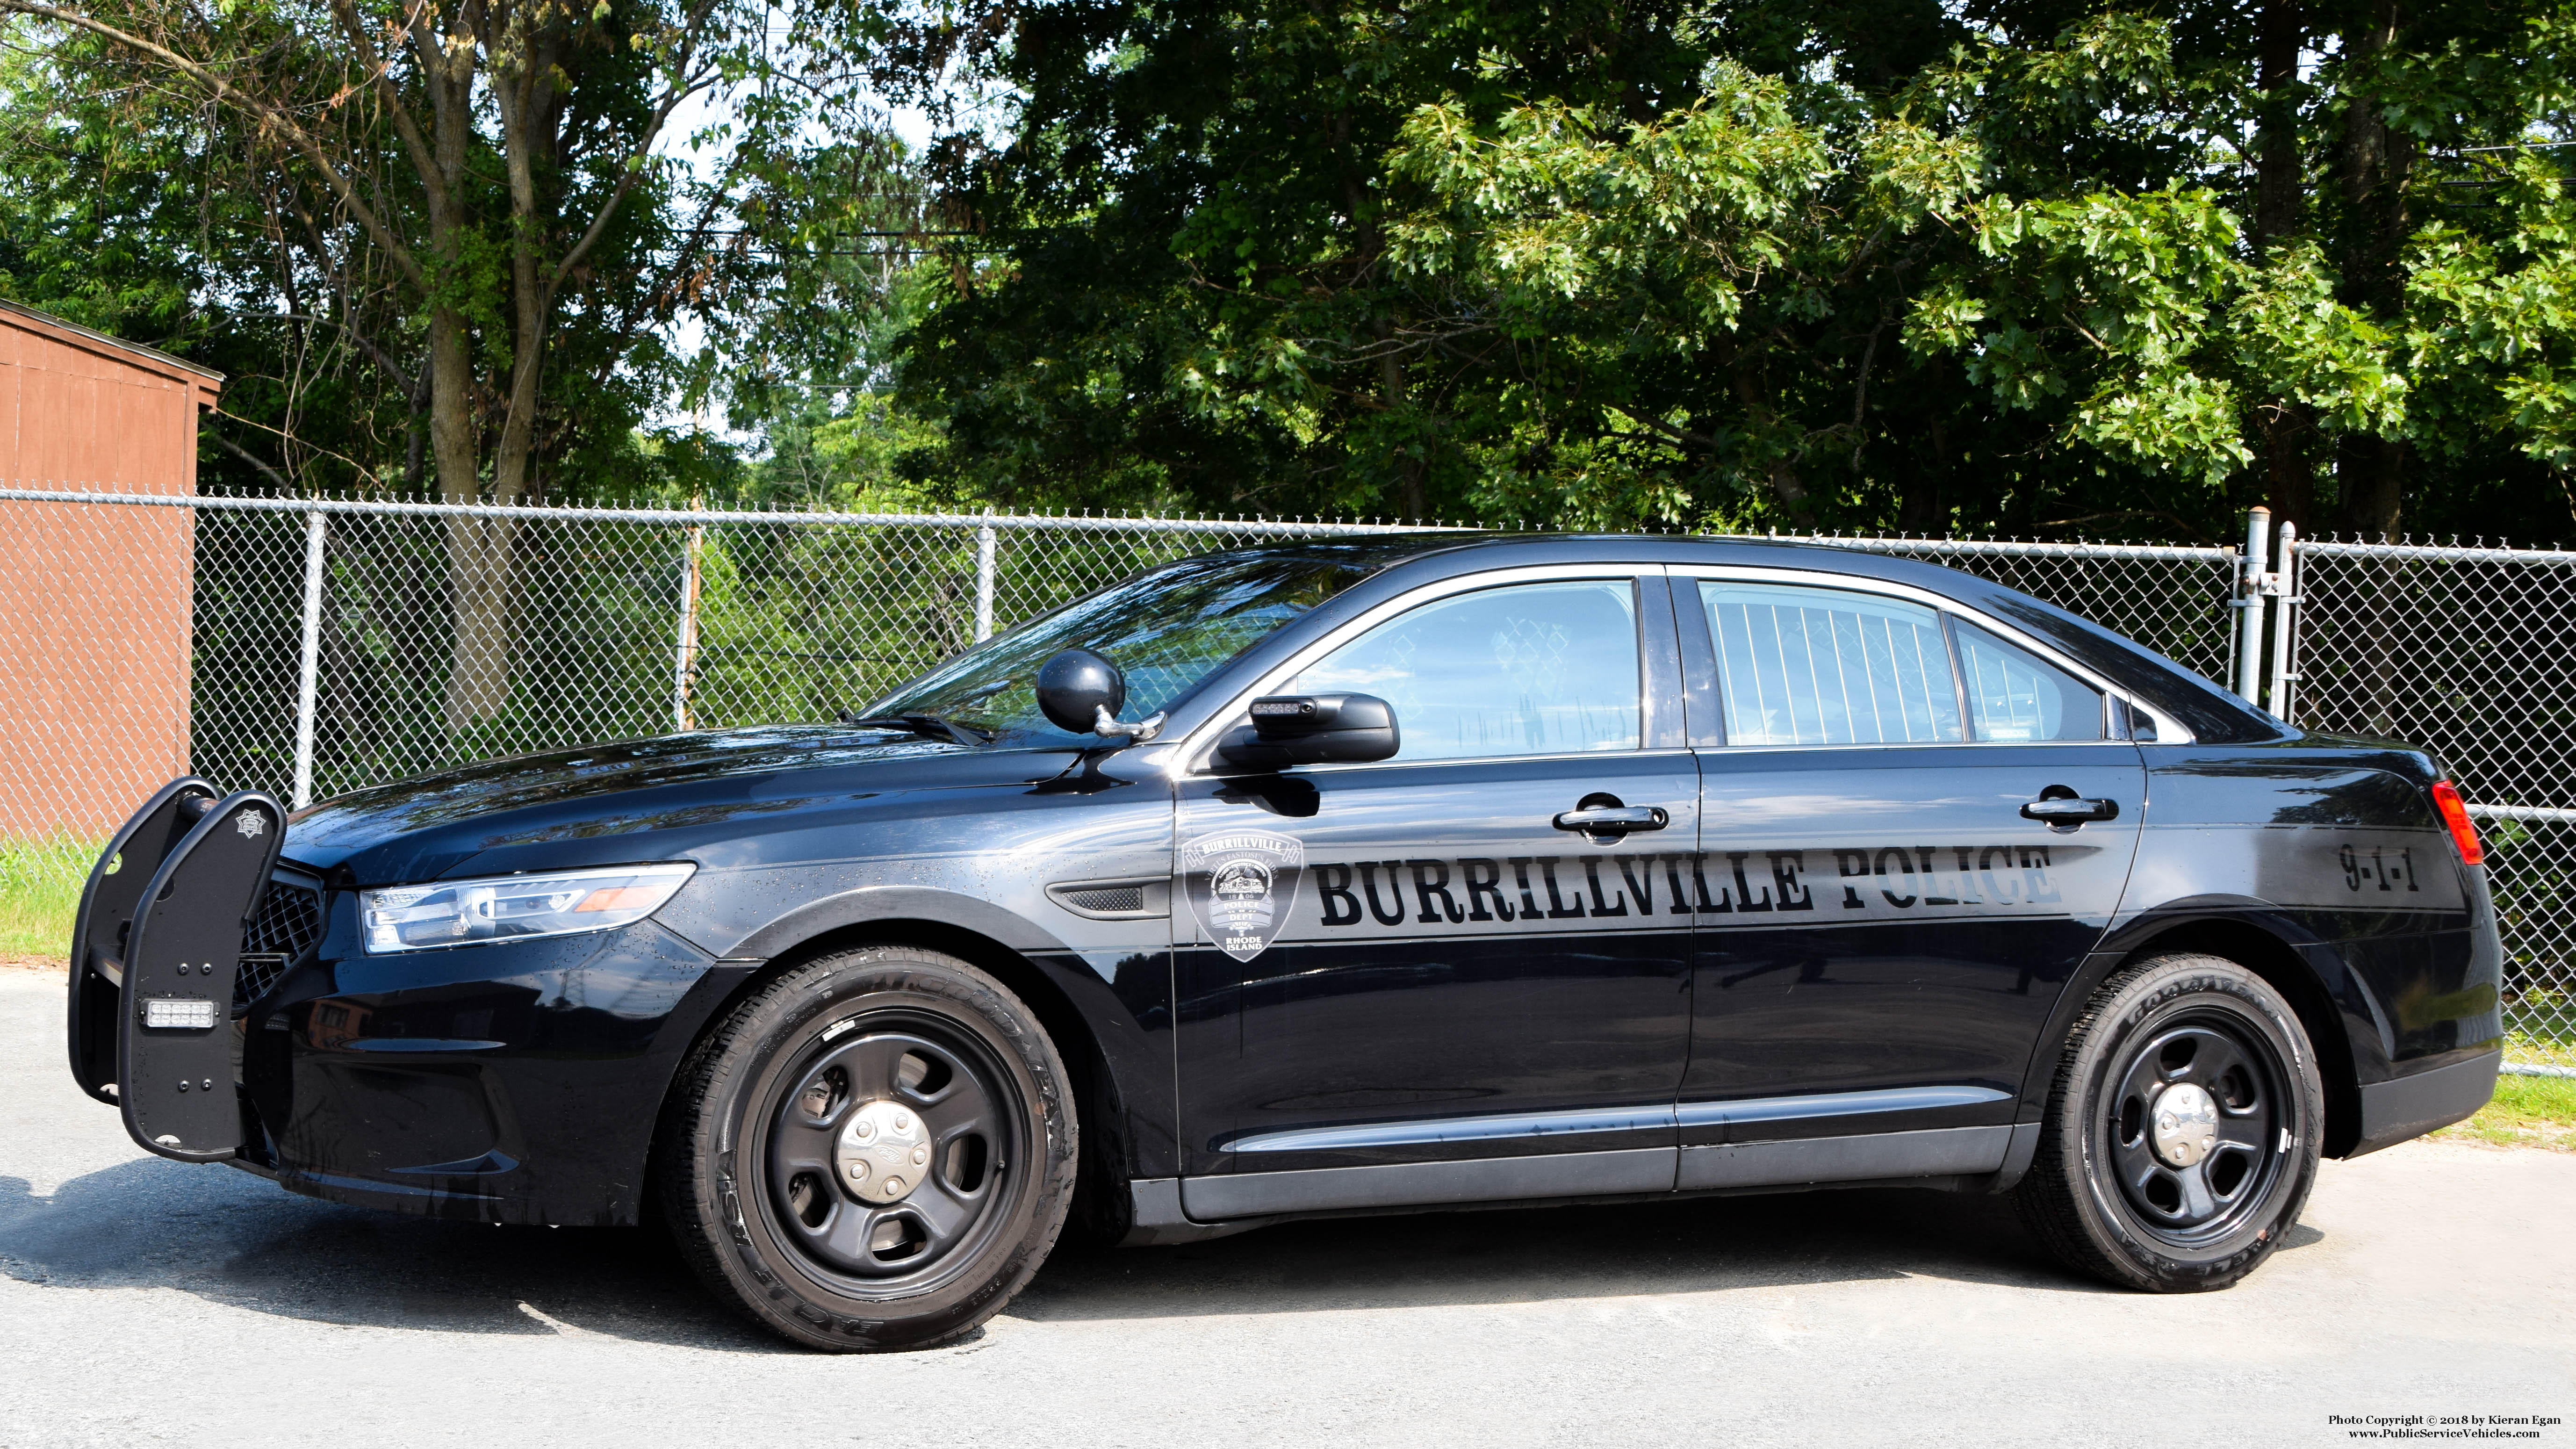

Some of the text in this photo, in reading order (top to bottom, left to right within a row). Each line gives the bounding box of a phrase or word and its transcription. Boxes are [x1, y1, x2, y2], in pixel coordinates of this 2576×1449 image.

[1202, 838, 1281, 854] BURRILLVILLE
[1227, 851, 1264, 861] FASTOSUS
[2339, 844, 2419, 891] 9-1-1
[1309, 845, 2062, 926] BURRILLVILLE POLICE
